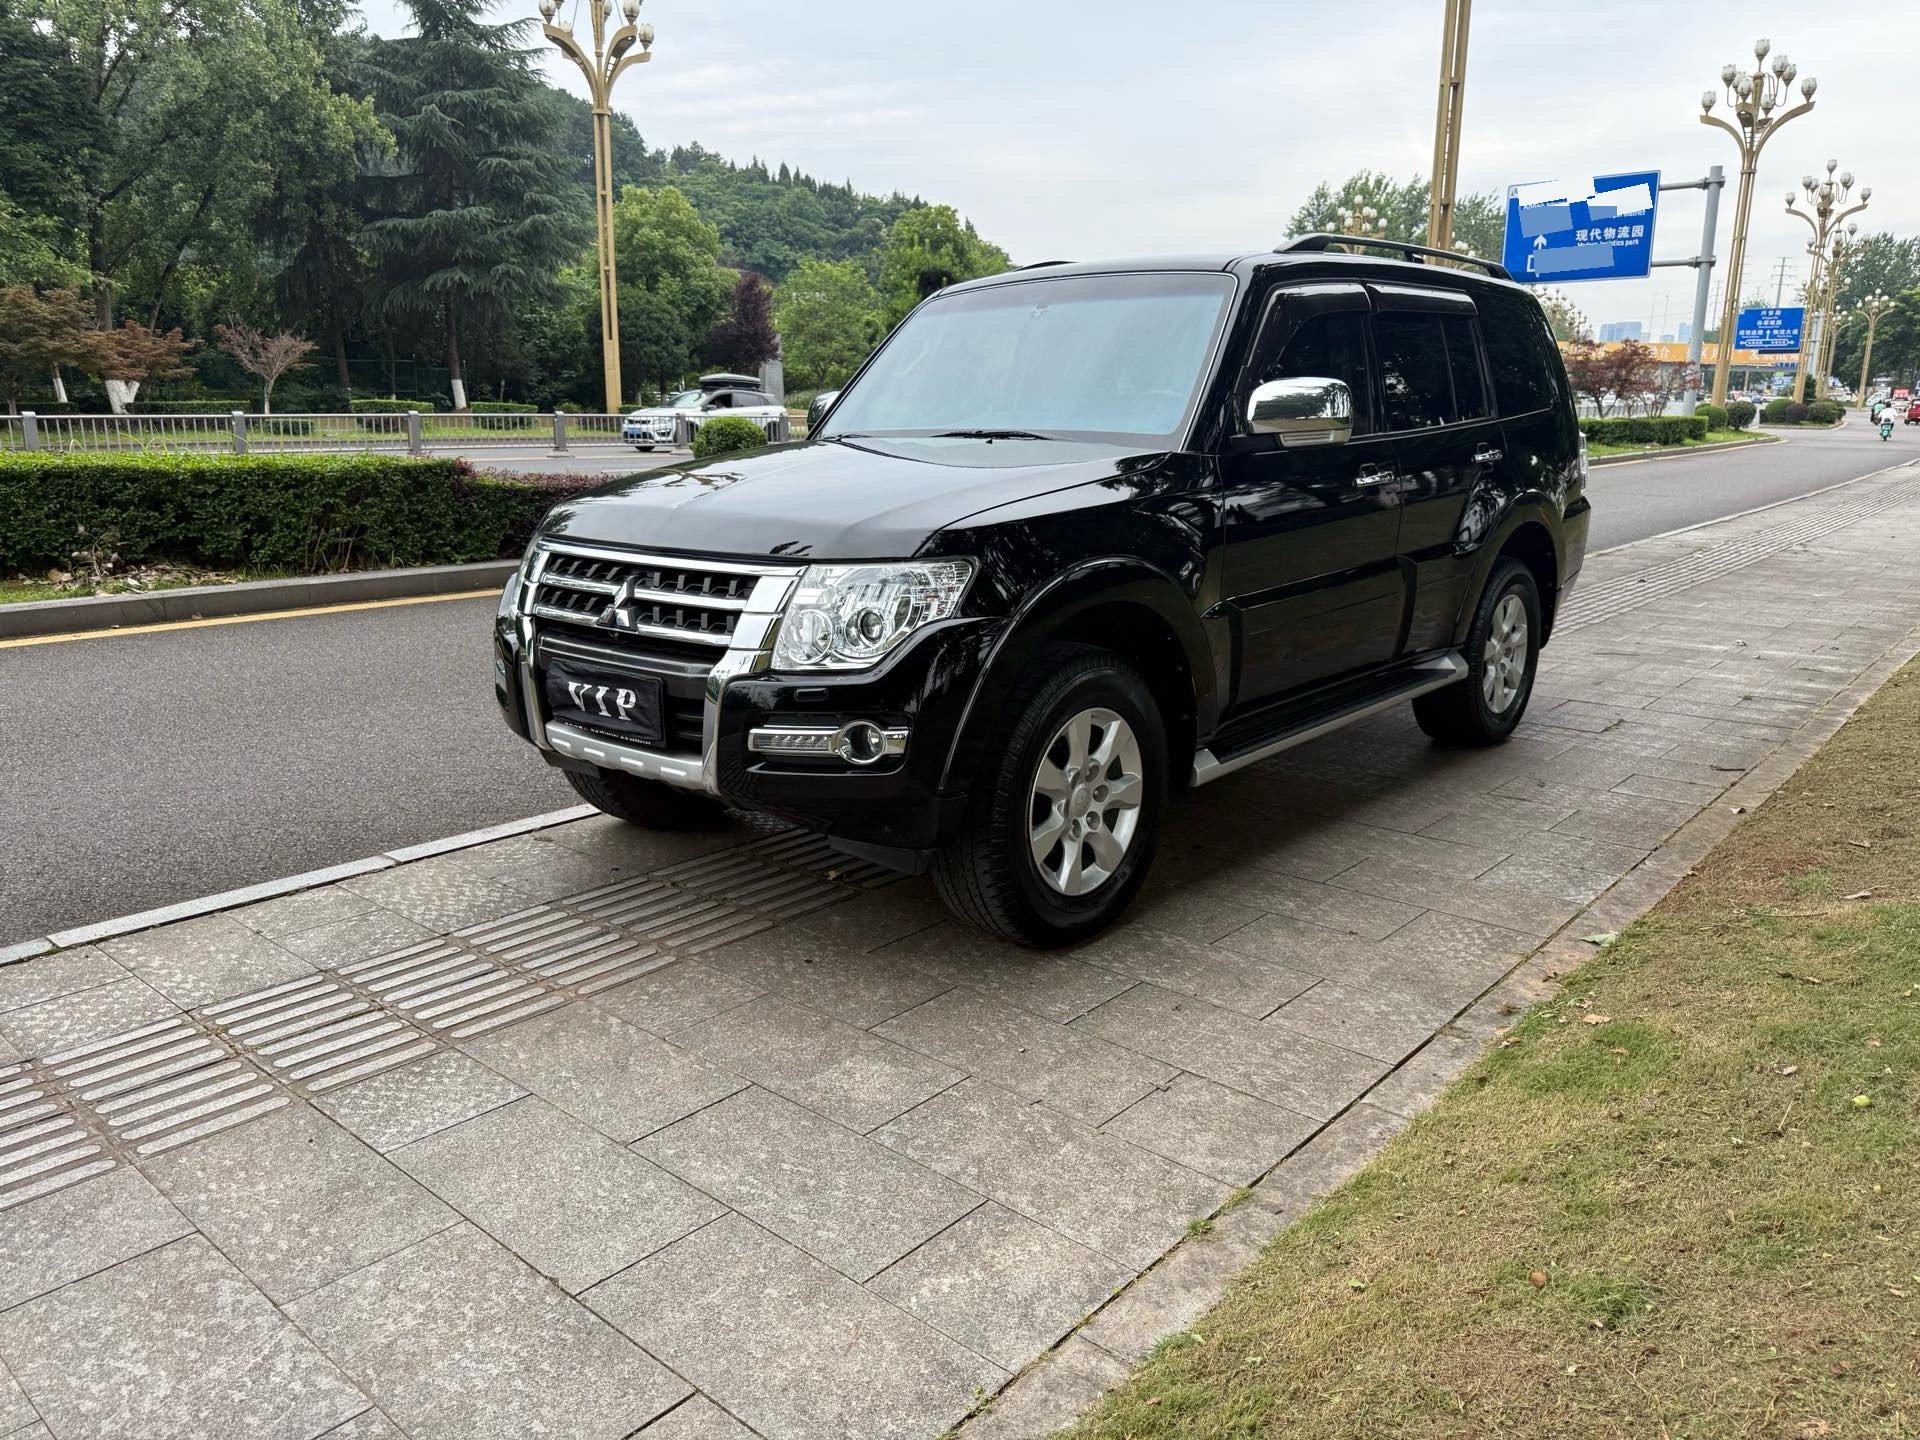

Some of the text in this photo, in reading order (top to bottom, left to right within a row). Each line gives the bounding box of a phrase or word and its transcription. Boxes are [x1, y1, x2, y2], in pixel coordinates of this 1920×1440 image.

[1575, 224, 1645, 242] 现代物流园
[1625, 239, 1639, 247] park
[568, 681, 636, 721] VIP
